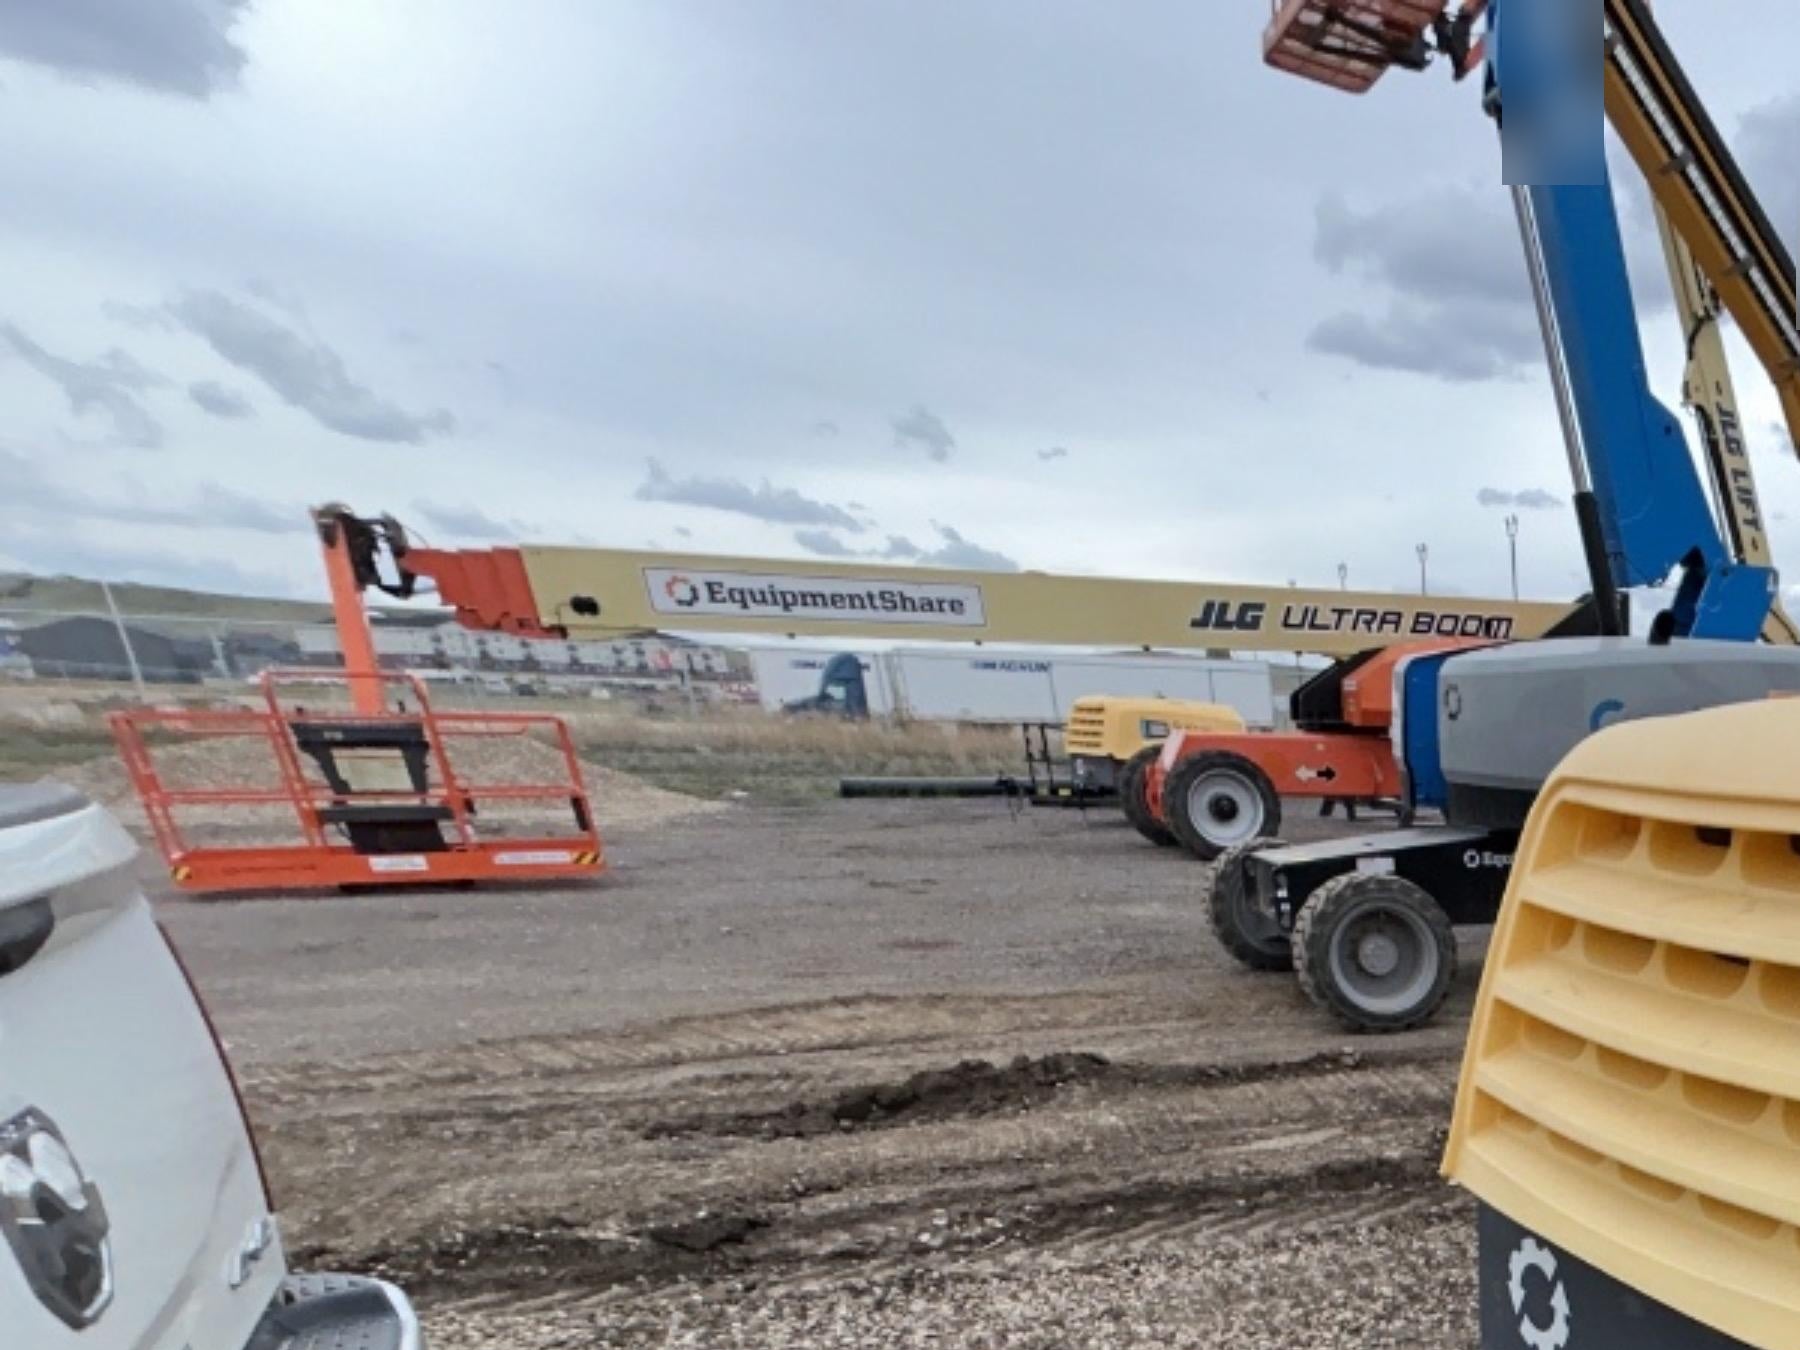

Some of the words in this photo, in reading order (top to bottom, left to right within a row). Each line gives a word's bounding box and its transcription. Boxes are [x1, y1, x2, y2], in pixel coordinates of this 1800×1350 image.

[704, 580, 965, 616] EquipmentShare
[1190, 600, 1267, 631] JLG
[1281, 605, 1403, 634] ULTRA
[1409, 611, 1513, 640] BOOM
